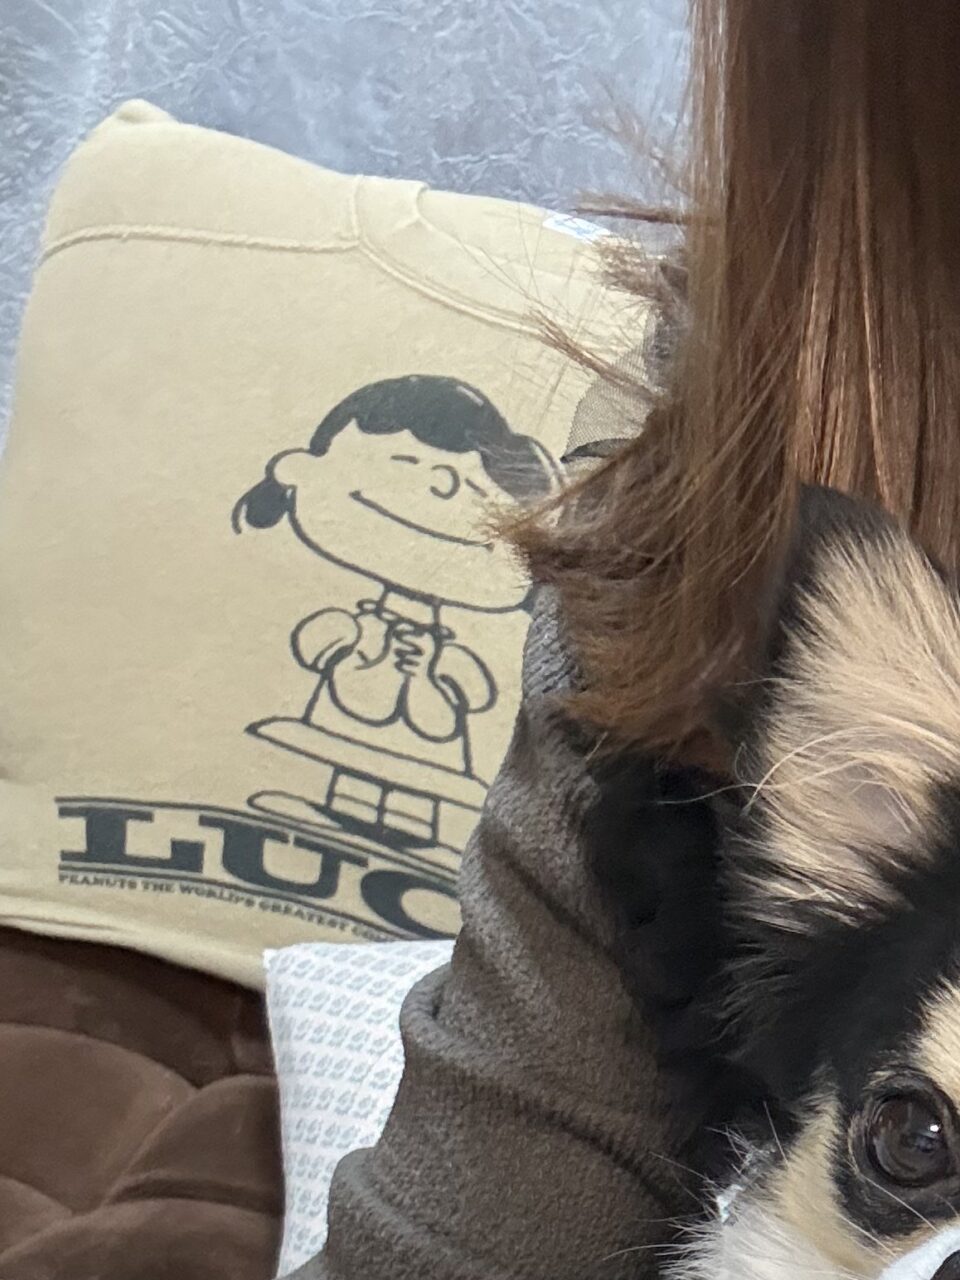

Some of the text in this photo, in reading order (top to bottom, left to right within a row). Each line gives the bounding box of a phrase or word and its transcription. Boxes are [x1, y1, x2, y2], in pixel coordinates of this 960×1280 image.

[59, 873, 137, 890] PEANUTS
[140, 878, 174, 893] THE
[258, 898, 349, 932] GREATEST
